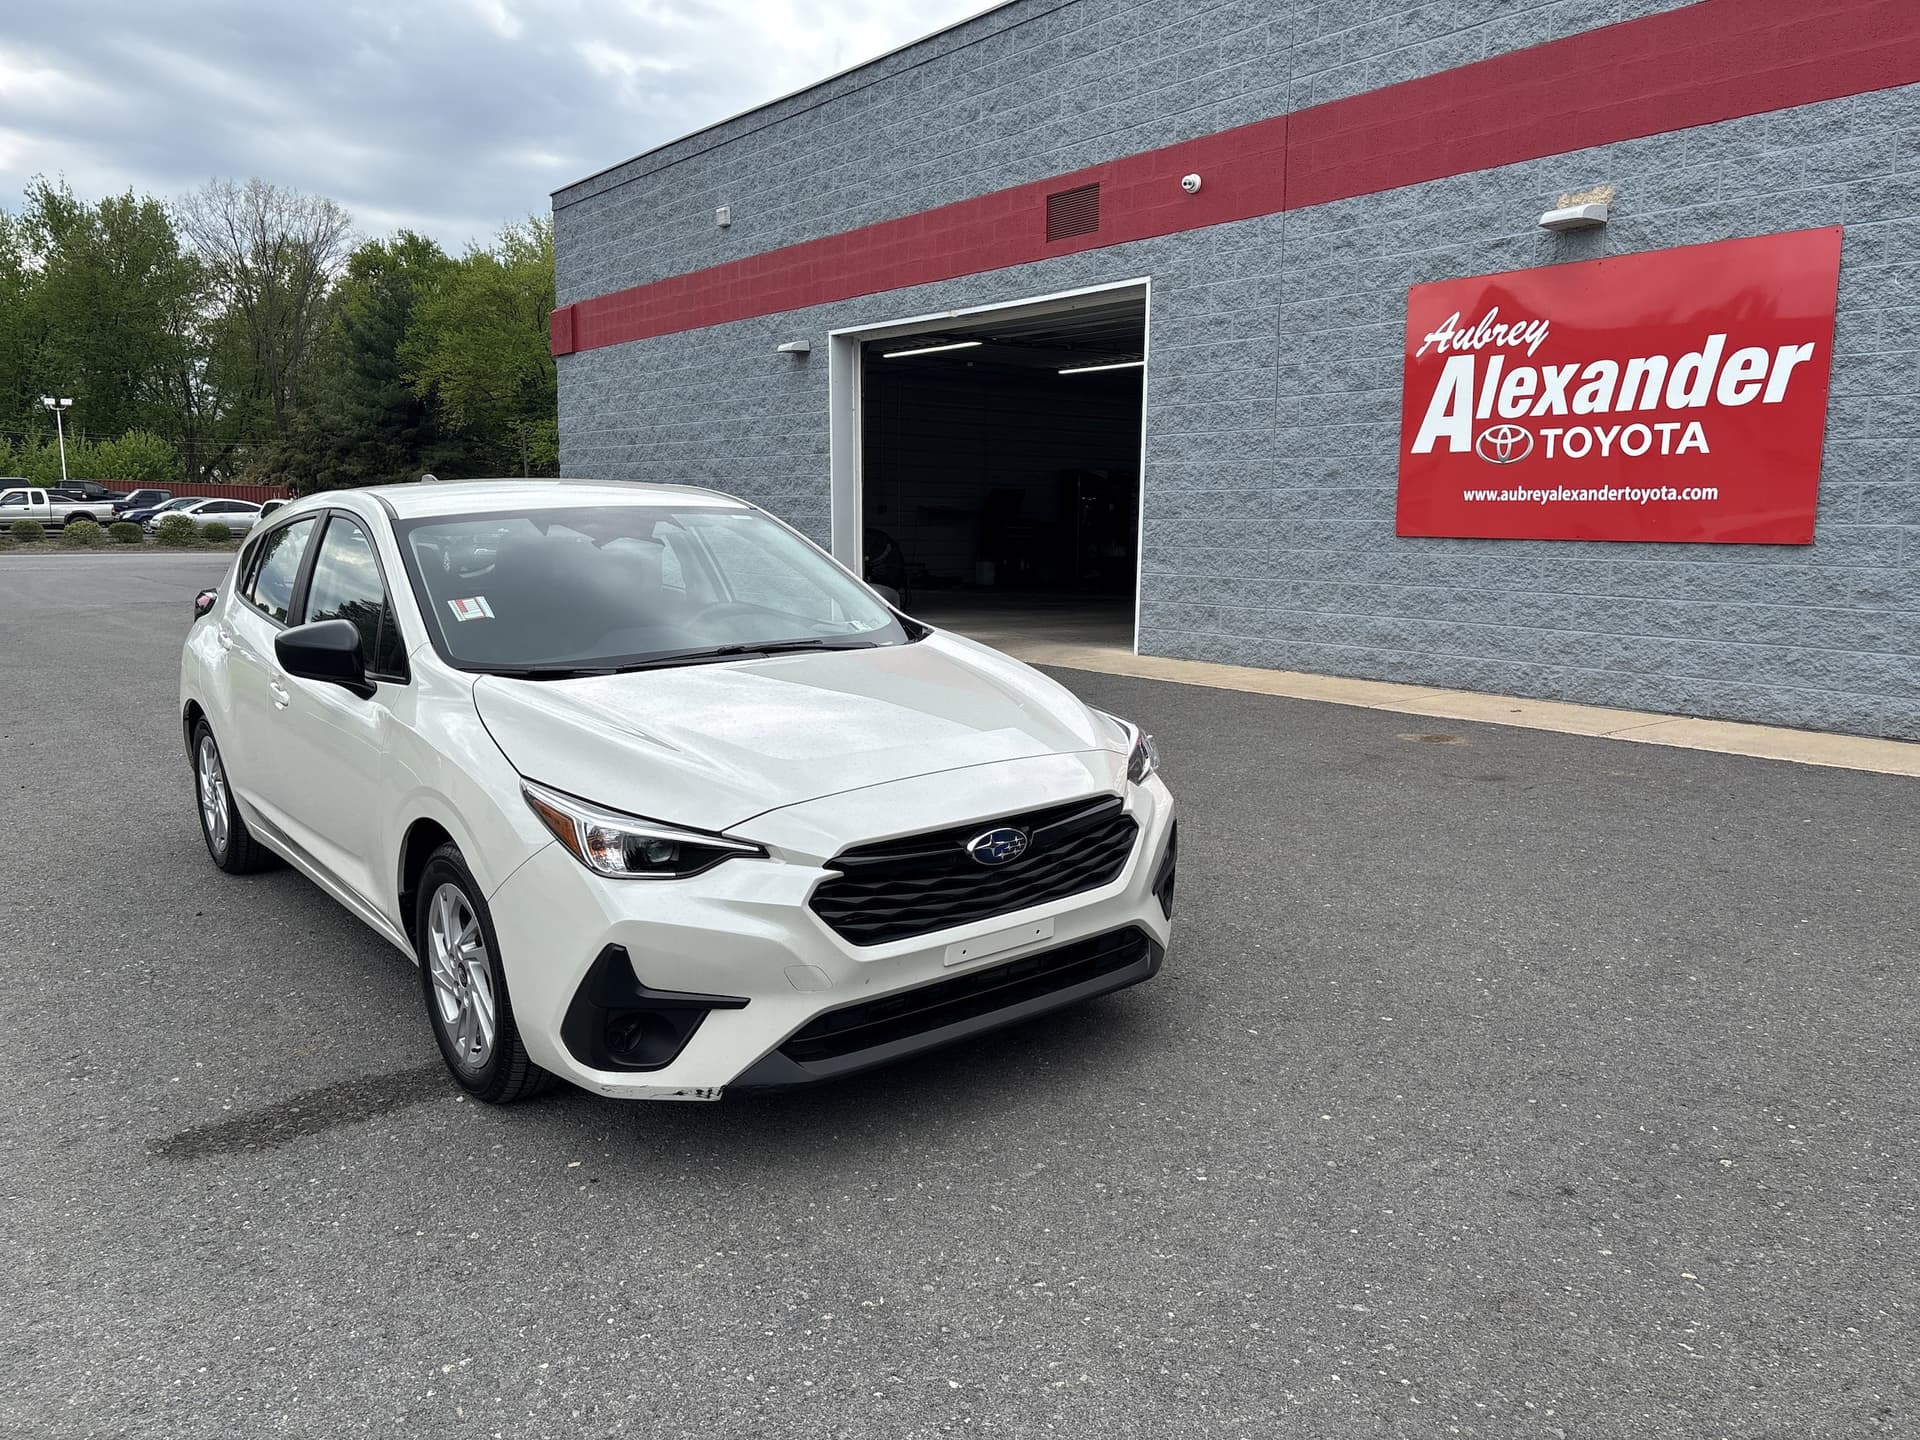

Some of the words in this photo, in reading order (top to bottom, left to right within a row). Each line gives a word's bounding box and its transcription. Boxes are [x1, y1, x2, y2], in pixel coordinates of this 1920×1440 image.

[1416, 306, 1550, 357] Aubrey
[1411, 333, 1815, 454] Alexander
[1540, 421, 1710, 459] TOYOTA
[1463, 484, 1719, 505] www.aubreyalexandertoyota.com
